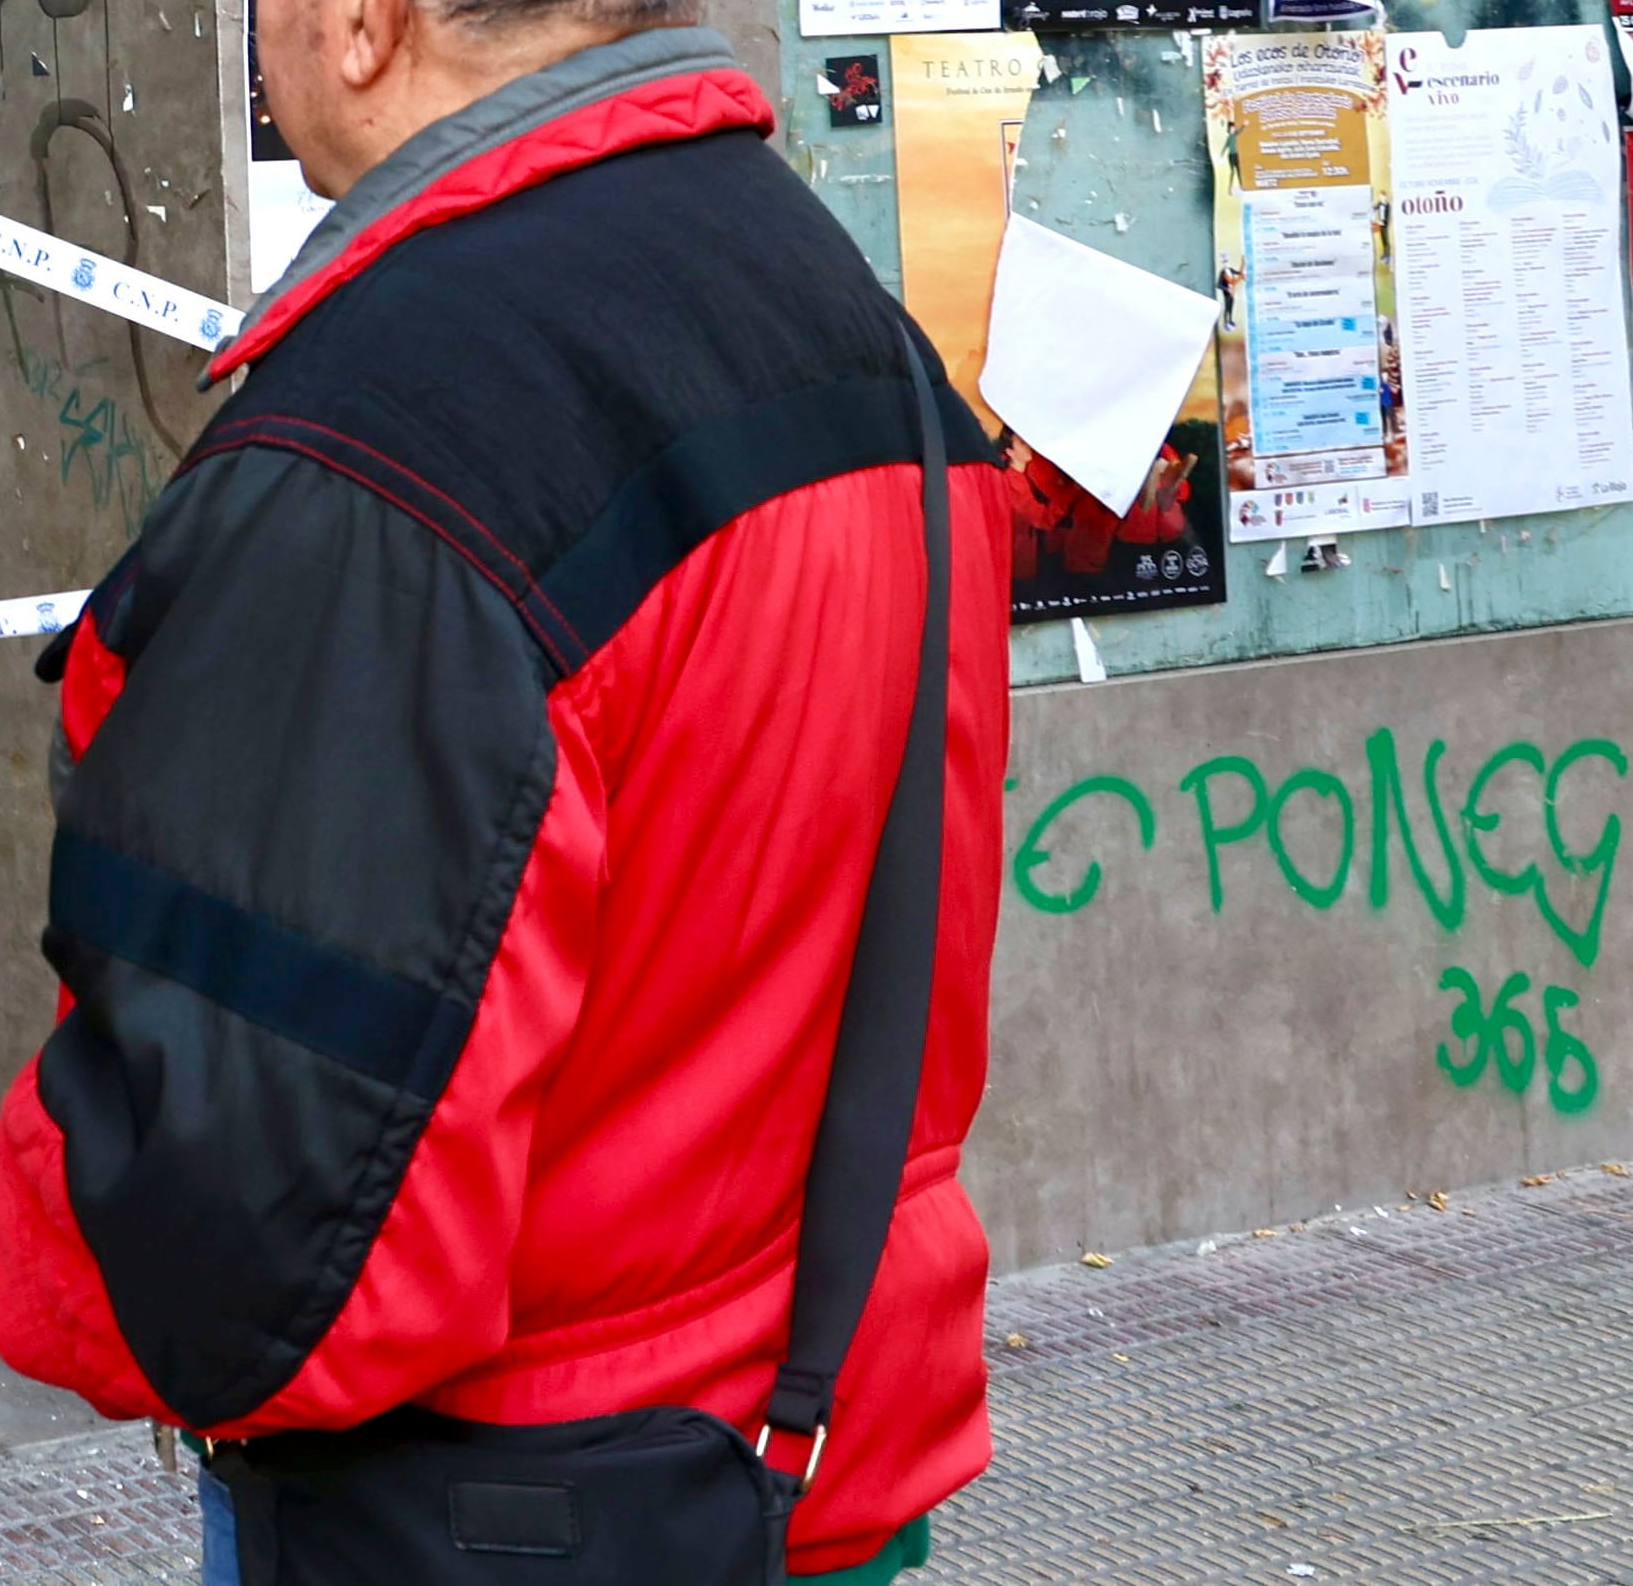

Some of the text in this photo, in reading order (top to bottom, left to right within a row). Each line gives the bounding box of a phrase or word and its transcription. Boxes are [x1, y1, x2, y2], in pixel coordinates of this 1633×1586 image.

[1231, 51, 1252, 68] Los
[1256, 46, 1287, 63] ecos
[1292, 44, 1310, 59] de
[922, 59, 1022, 79] TEATRO
[1427, 71, 1500, 89] escenario
[1428, 91, 1460, 106] vivo
[1401, 190, 1464, 216] otoño
[112, 281, 178, 318] C.N.P.
